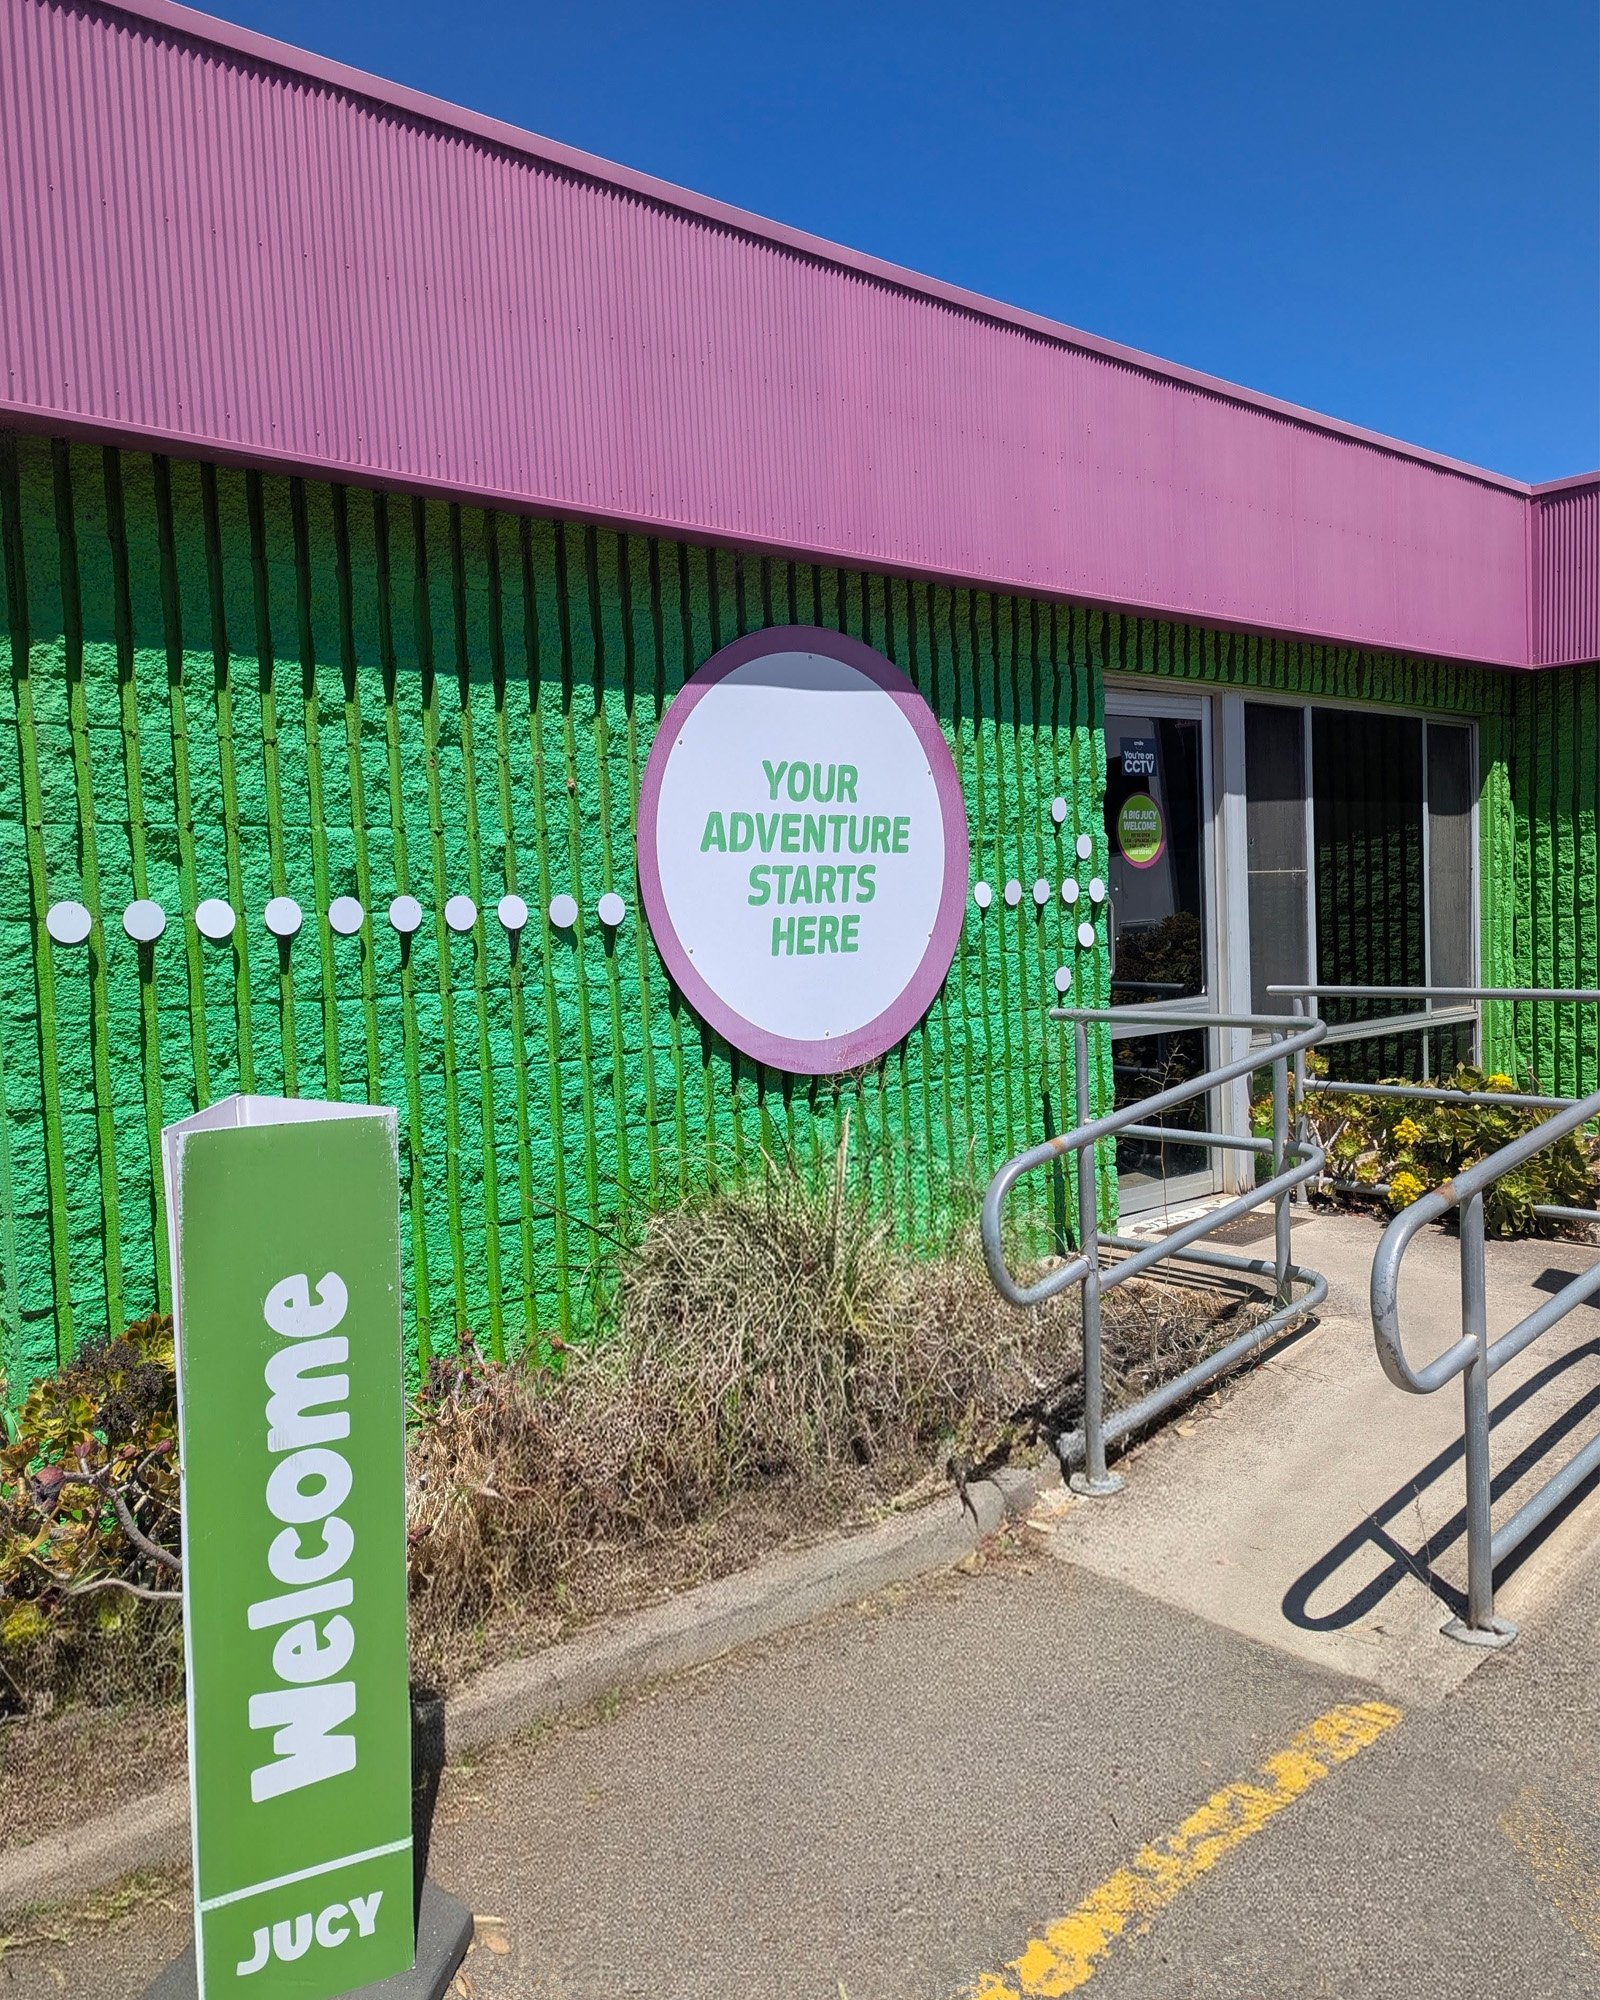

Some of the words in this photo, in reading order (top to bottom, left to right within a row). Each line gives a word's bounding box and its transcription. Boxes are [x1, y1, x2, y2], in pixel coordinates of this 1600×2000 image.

[1124, 750, 1145, 760] You're
[1145, 752, 1155, 760] on
[1124, 760, 1155, 773] CCTV
[762, 760, 858, 803] YOUR
[700, 812, 910, 854] ADVENTURE
[1122, 810, 1128, 820] A
[1128, 810, 1140, 820] BIG
[1140, 810, 1157, 820] JUCY
[1123, 821, 1157, 831] WELCOME
[748, 865, 876, 906] STARTS
[772, 915, 860, 956] HERE
[248, 1272, 356, 1803] Welcome
[237, 1890, 384, 1976] JUCY
